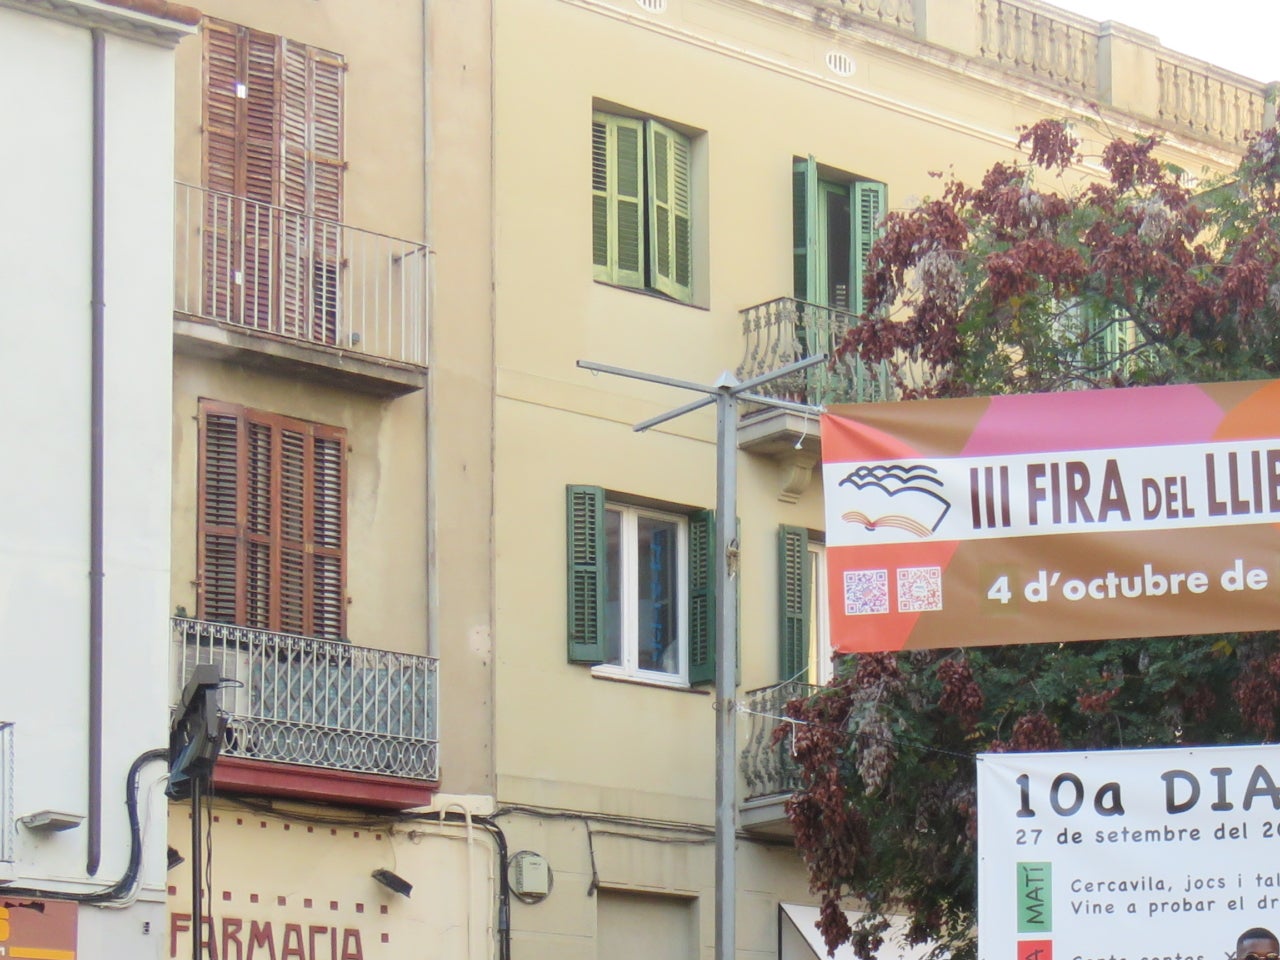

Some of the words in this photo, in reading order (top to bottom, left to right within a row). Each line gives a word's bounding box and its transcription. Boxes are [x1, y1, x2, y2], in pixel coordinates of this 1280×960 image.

[970, 466, 1011, 529] III
[1026, 458, 1131, 526] FIRA
[1141, 475, 1195, 520] DEL
[987, 577, 1012, 604] 4
[1024, 563, 1208, 603] d'octubre
[1221, 560, 1268, 592] de
[1016, 772, 1125, 818] 10a
[1016, 829, 1043, 846] 27
[1057, 828, 1082, 845] de
[1095, 824, 1201, 843] setembre
[1213, 822, 1247, 841] del
[1024, 865, 1045, 925] MATÍ
[1070, 876, 1173, 893] Cercavila,
[1185, 874, 1226, 893] jocs
[1238, 873, 1242, 888] i
[1070, 898, 1115, 915] Vine
[1127, 902, 1137, 914] a
[1149, 897, 1216, 917] probar
[1227, 895, 1244, 910] el
